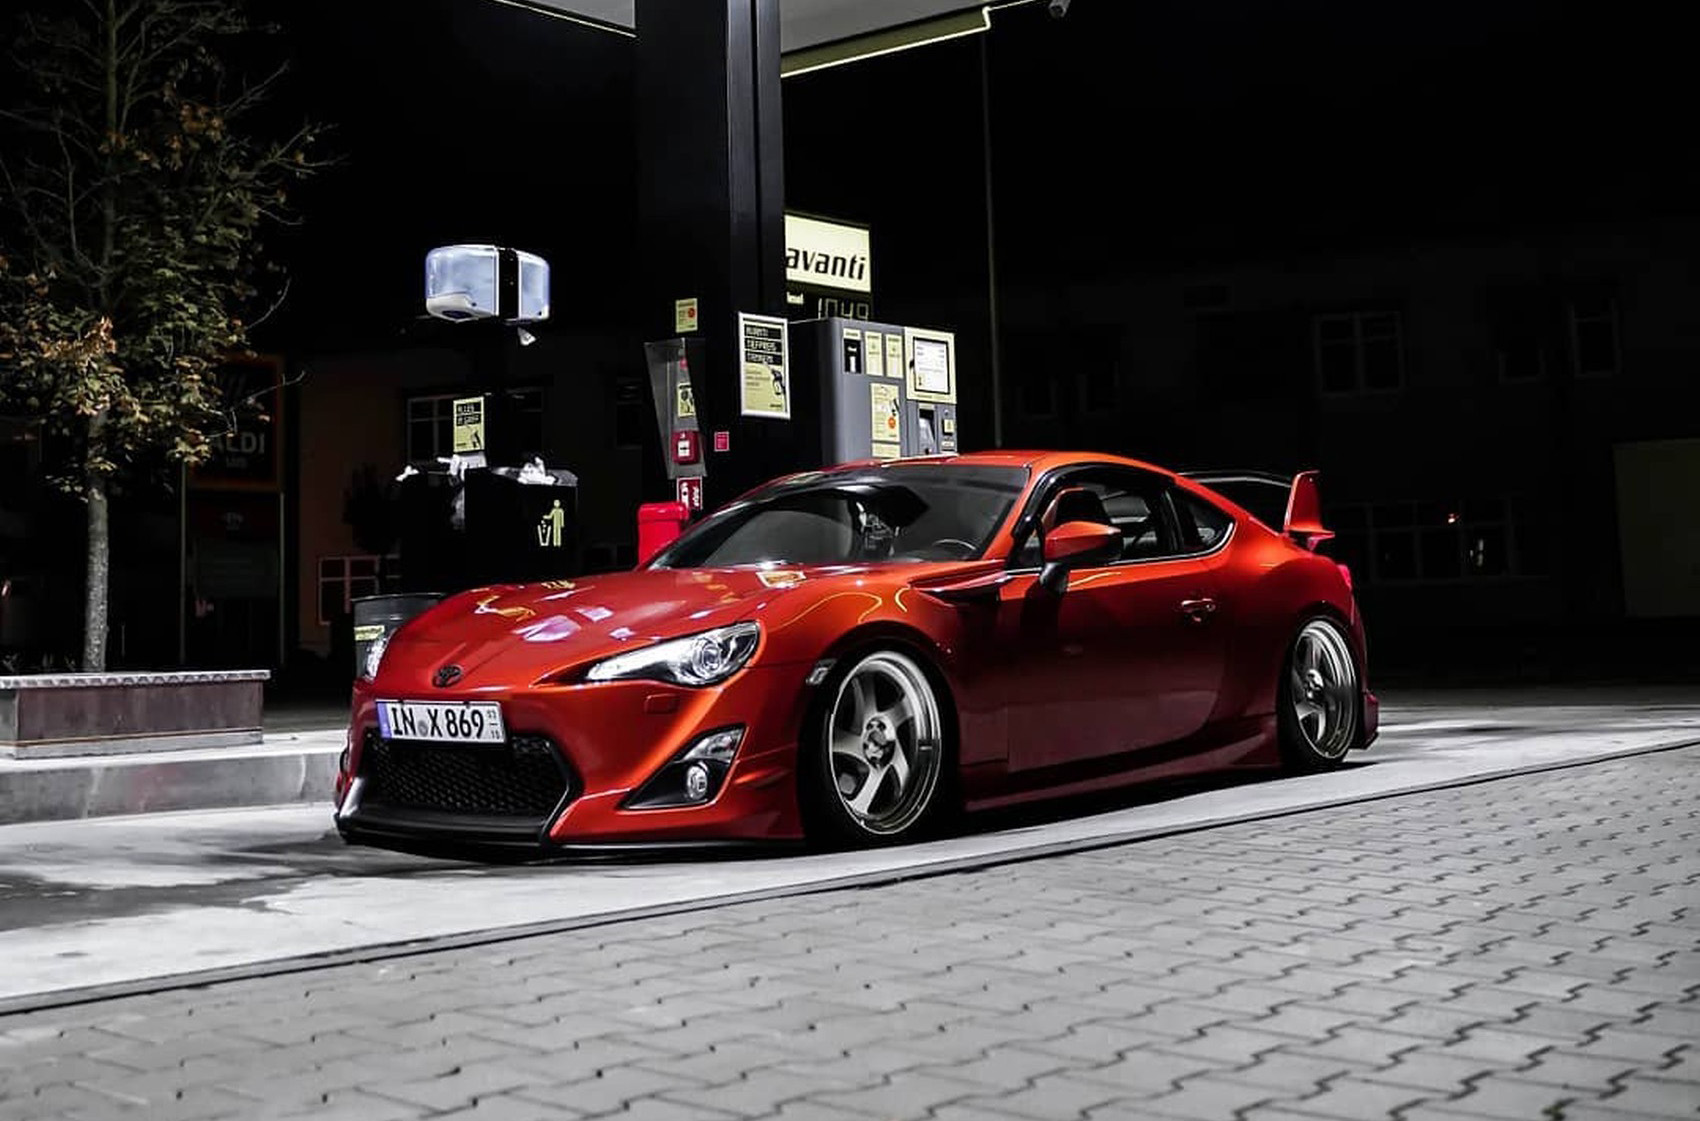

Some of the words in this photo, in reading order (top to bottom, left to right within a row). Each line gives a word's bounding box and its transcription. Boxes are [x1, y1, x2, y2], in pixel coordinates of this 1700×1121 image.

[785, 247, 867, 281] avanti
[390, 706, 417, 736] IN
[427, 708, 443, 737] X
[444, 708, 485, 739] 869
